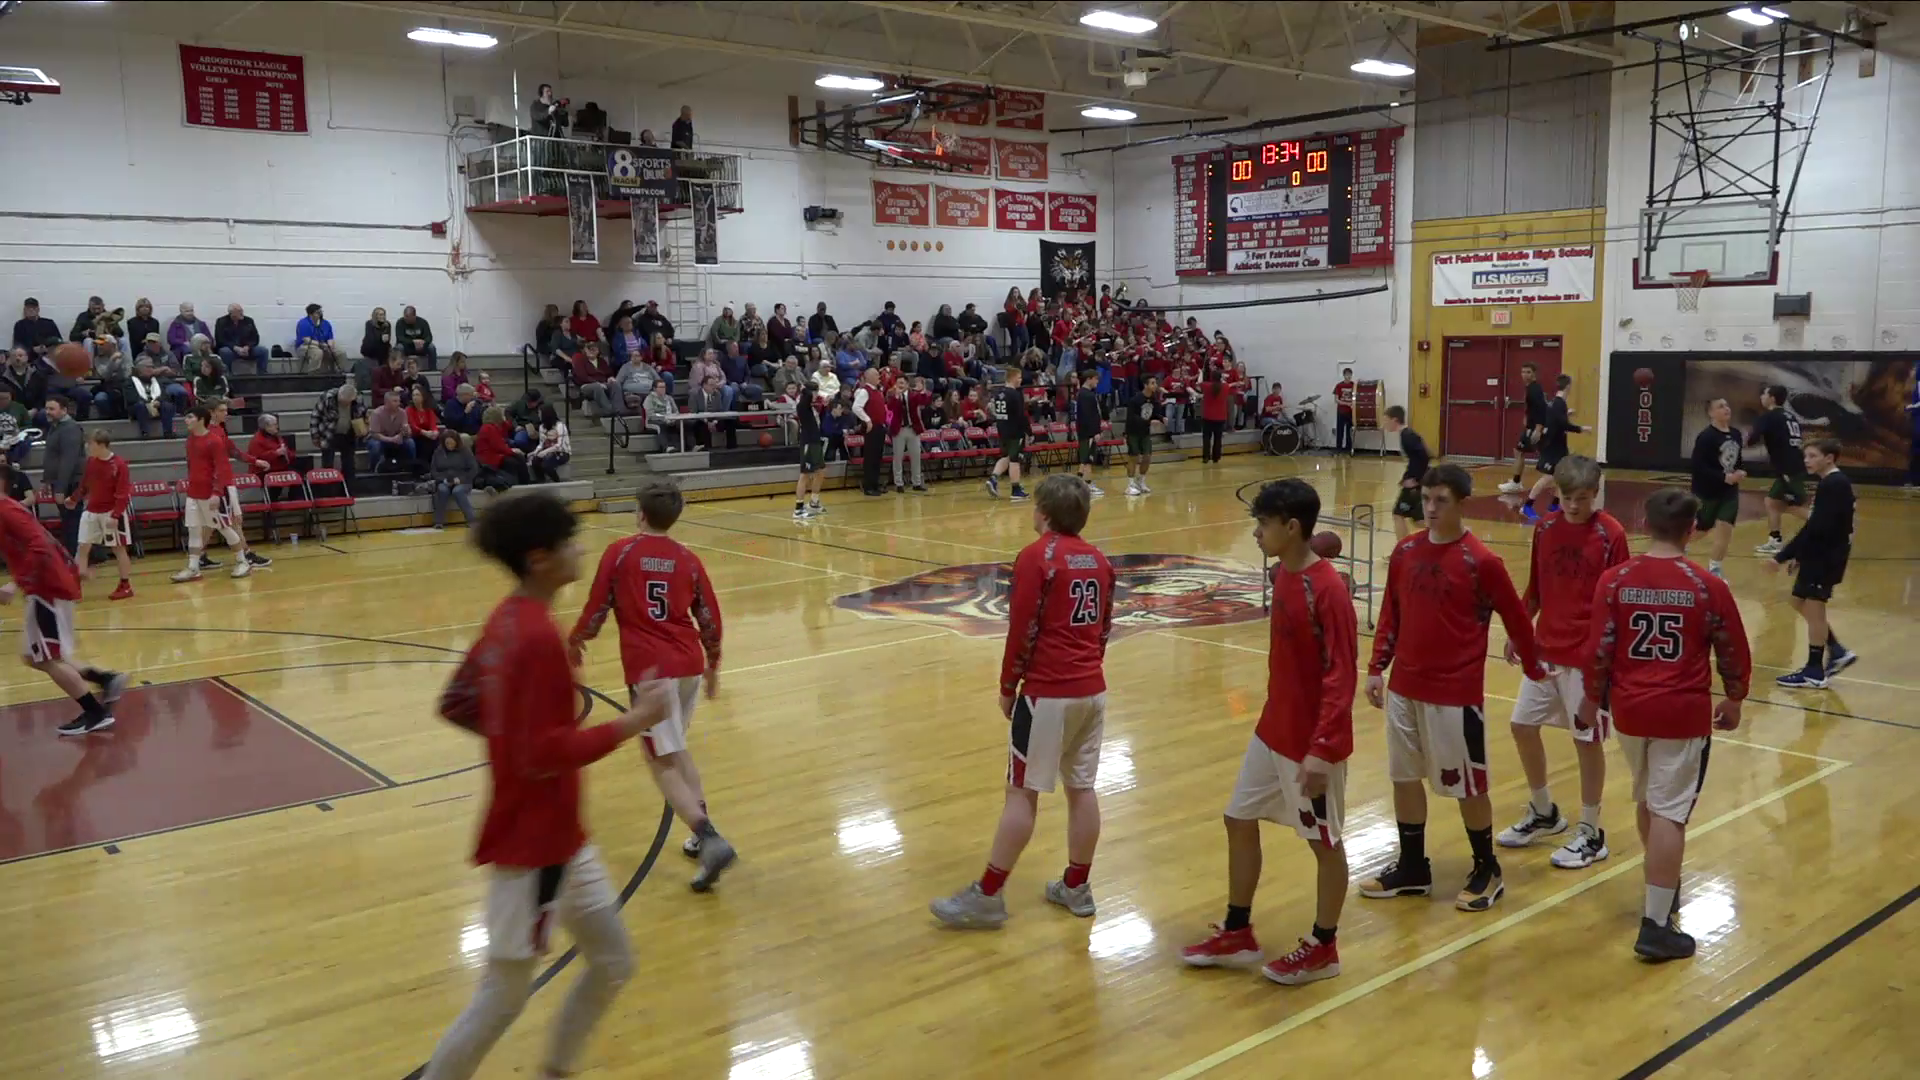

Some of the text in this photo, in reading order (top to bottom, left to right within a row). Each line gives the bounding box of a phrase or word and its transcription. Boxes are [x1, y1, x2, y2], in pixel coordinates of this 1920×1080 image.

[190, 63, 297, 80] VOLLEYBALL CHAMPIONS
[199, 56, 288, 71] AROOSTOOK LEAGUE
[1262, 141, 1300, 165] 13:34
[613, 148, 636, 177] 8
[633, 158, 671, 169] SPORTS
[1306, 150, 1327, 173] 00
[1232, 160, 1252, 181] 00
[1292, 170, 1300, 186] 0
[613, 176, 638, 185] WAGM
[1252, 249, 1301, 260] Fort Fairfield
[1435, 248, 1592, 264] Fort Fairfield Middle High School
[1234, 258, 1320, 271] Athletic Boosters Club
[1522, 295, 1536, 304] High
[995, 400, 1007, 413] 32
[1637, 386, 1652, 442] ORT
[1786, 420, 1801, 437] 10
[269, 474, 297, 482] TIGERS
[312, 470, 339, 479] TIGERS
[134, 483, 165, 493] TIGERS
[646, 580, 668, 621] 5
[1069, 578, 1100, 626] 23
[1628, 611, 1684, 662] 25
